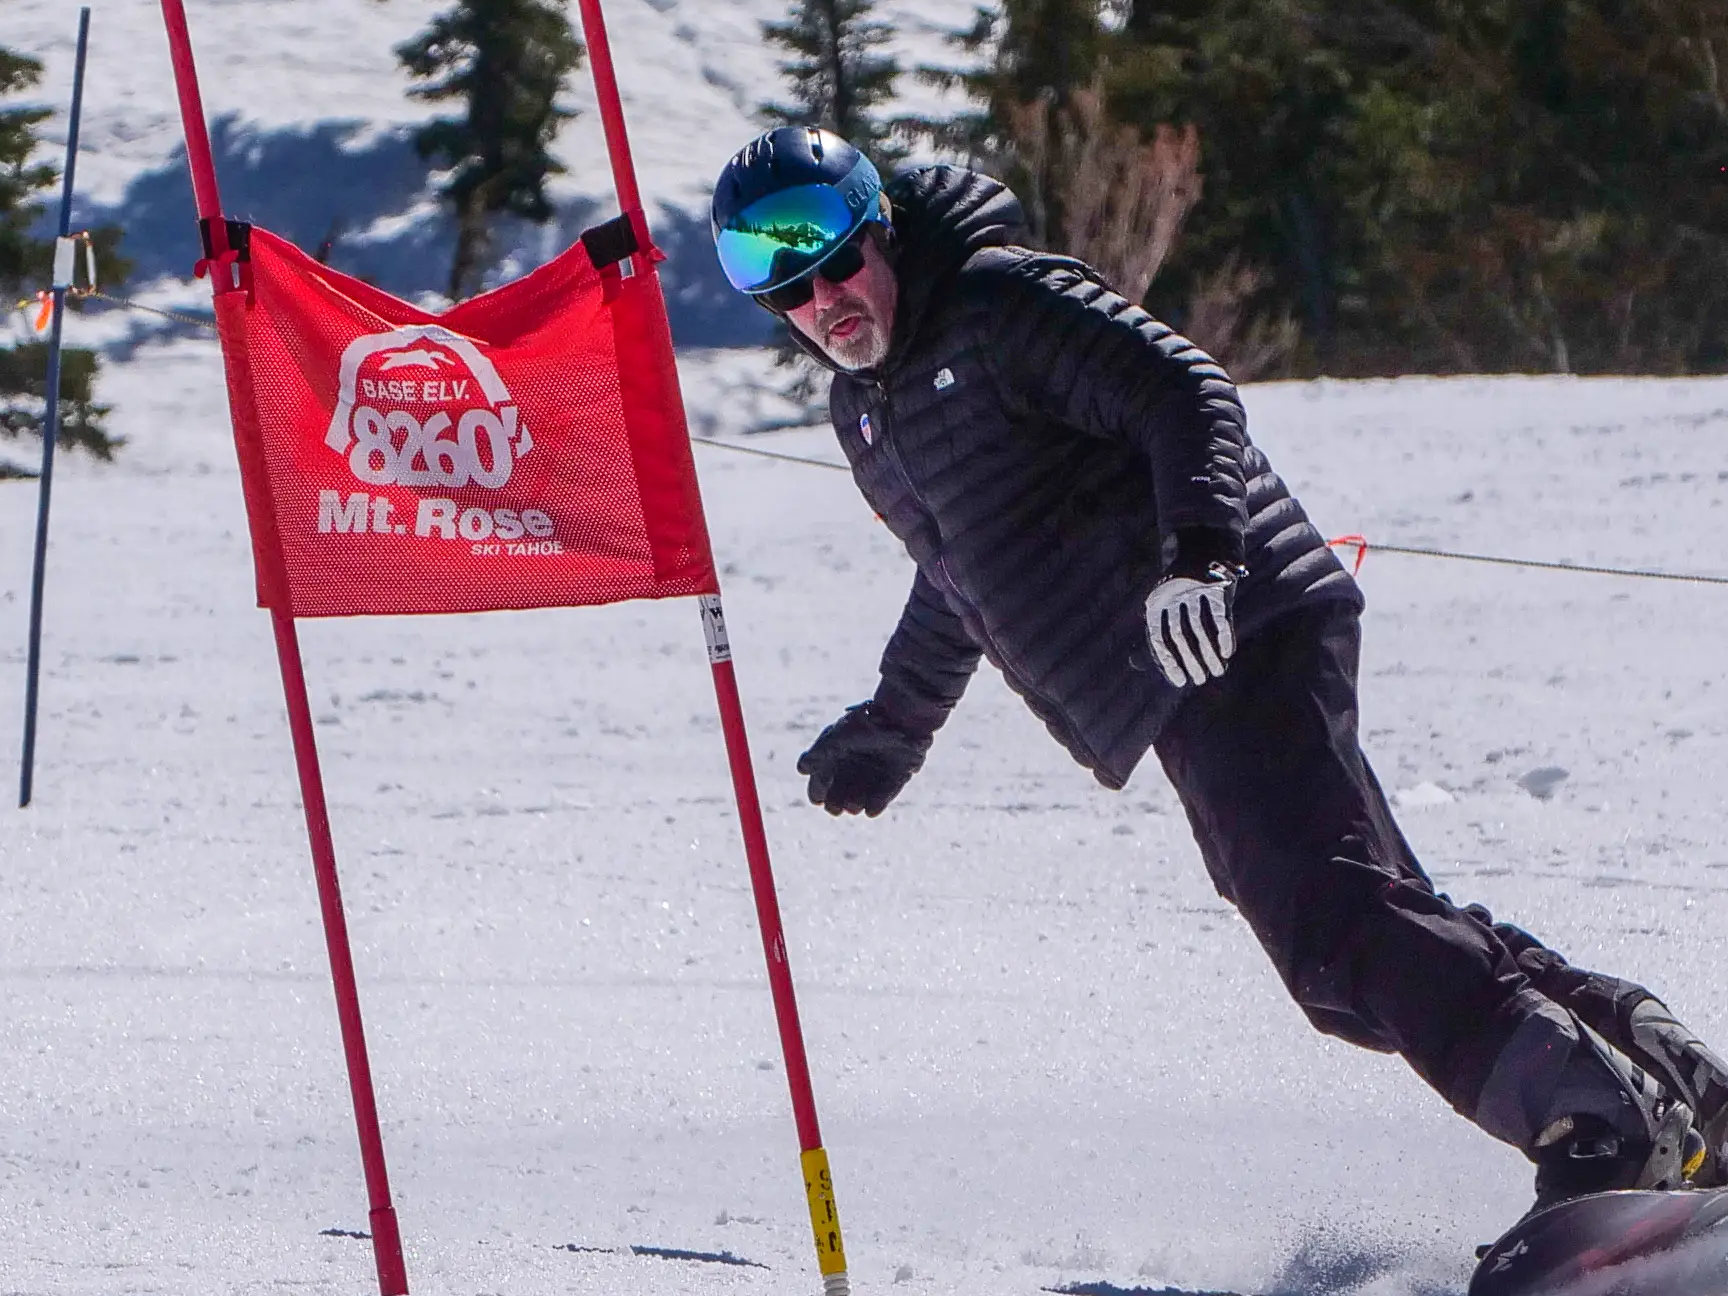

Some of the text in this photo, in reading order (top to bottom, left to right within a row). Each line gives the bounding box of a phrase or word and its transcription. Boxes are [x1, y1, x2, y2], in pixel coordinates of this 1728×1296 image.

[362, 379, 470, 402] BASE ELV.
[349, 405, 518, 489] 8260'
[318, 490, 553, 540] Mt. Rose
[471, 542, 563, 556] SKI TAHOE
